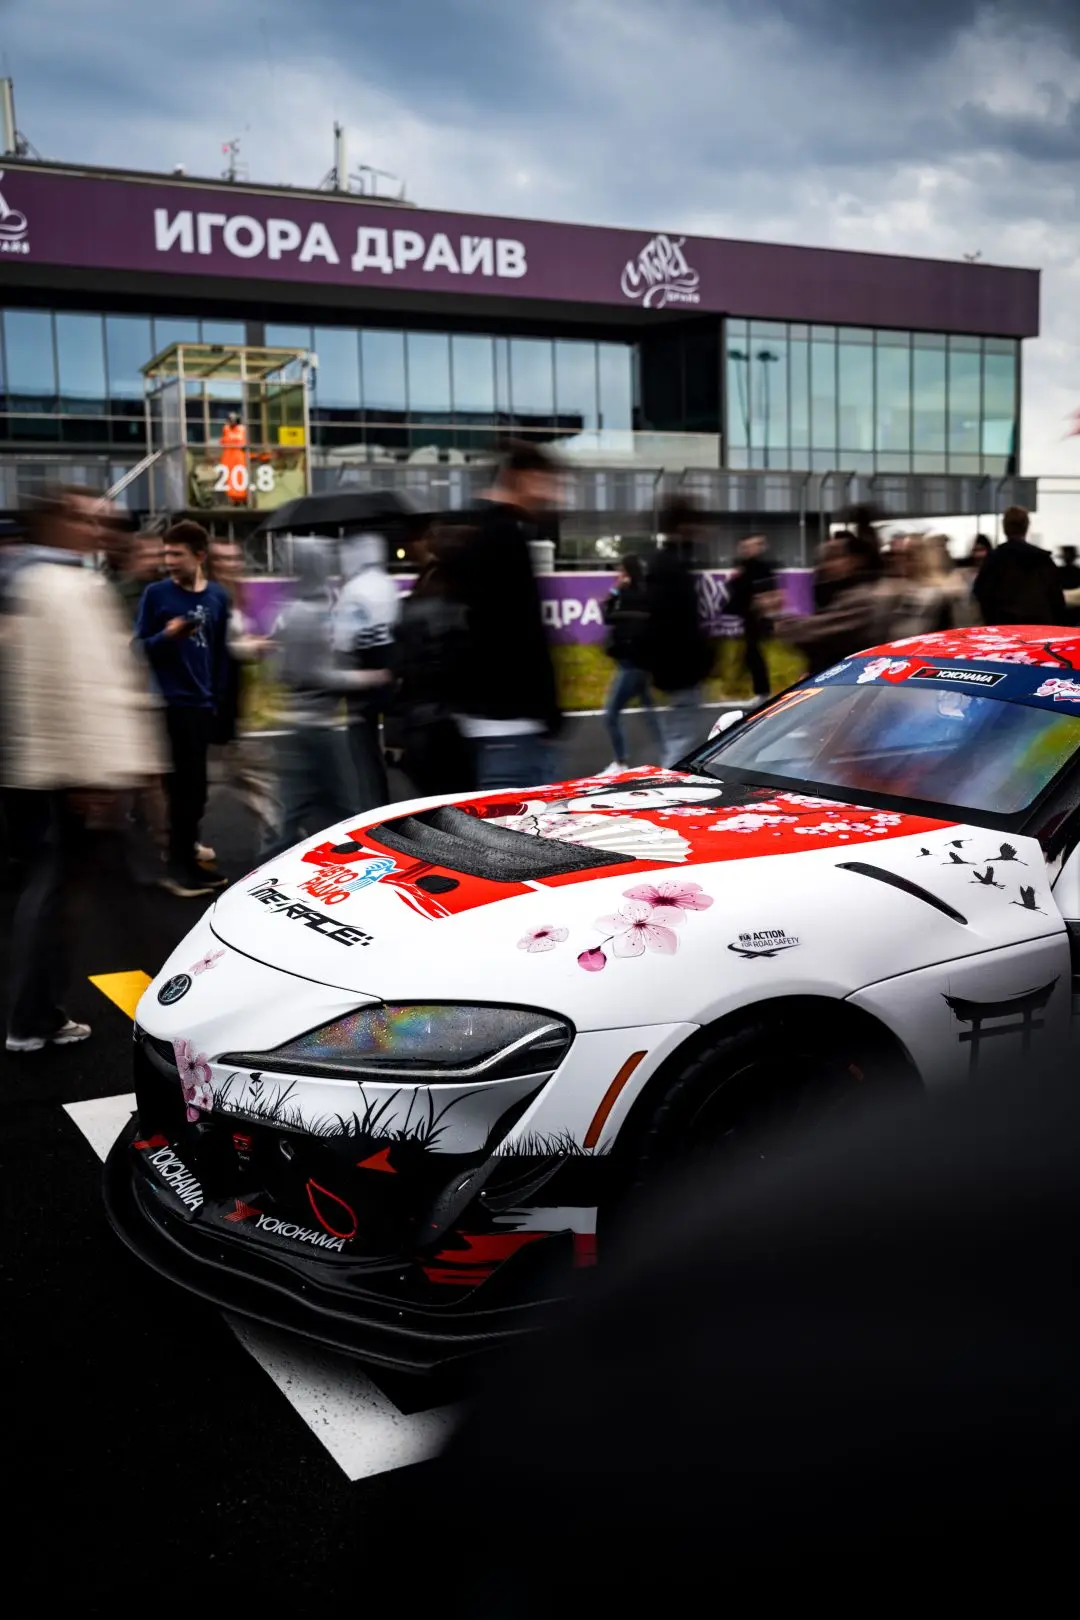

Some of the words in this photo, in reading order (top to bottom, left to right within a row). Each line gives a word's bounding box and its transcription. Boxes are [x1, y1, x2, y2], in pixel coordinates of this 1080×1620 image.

[154, 208, 340, 265] ИГОРА
[352, 226, 527, 278] ДРАЙВ
[213, 463, 275, 492] 20.8
[541, 598, 603, 629] ДРА
[936, 670, 993, 683] YOKOHAMA
[296, 876, 351, 905] РАДИО
[753, 929, 785, 940] ACTION
[753, 939, 774, 948] ROAD
[774, 937, 799, 946] SAFETY
[149, 1145, 204, 1212] YOKOHAMA
[254, 1213, 346, 1253] YOKOHAMA
